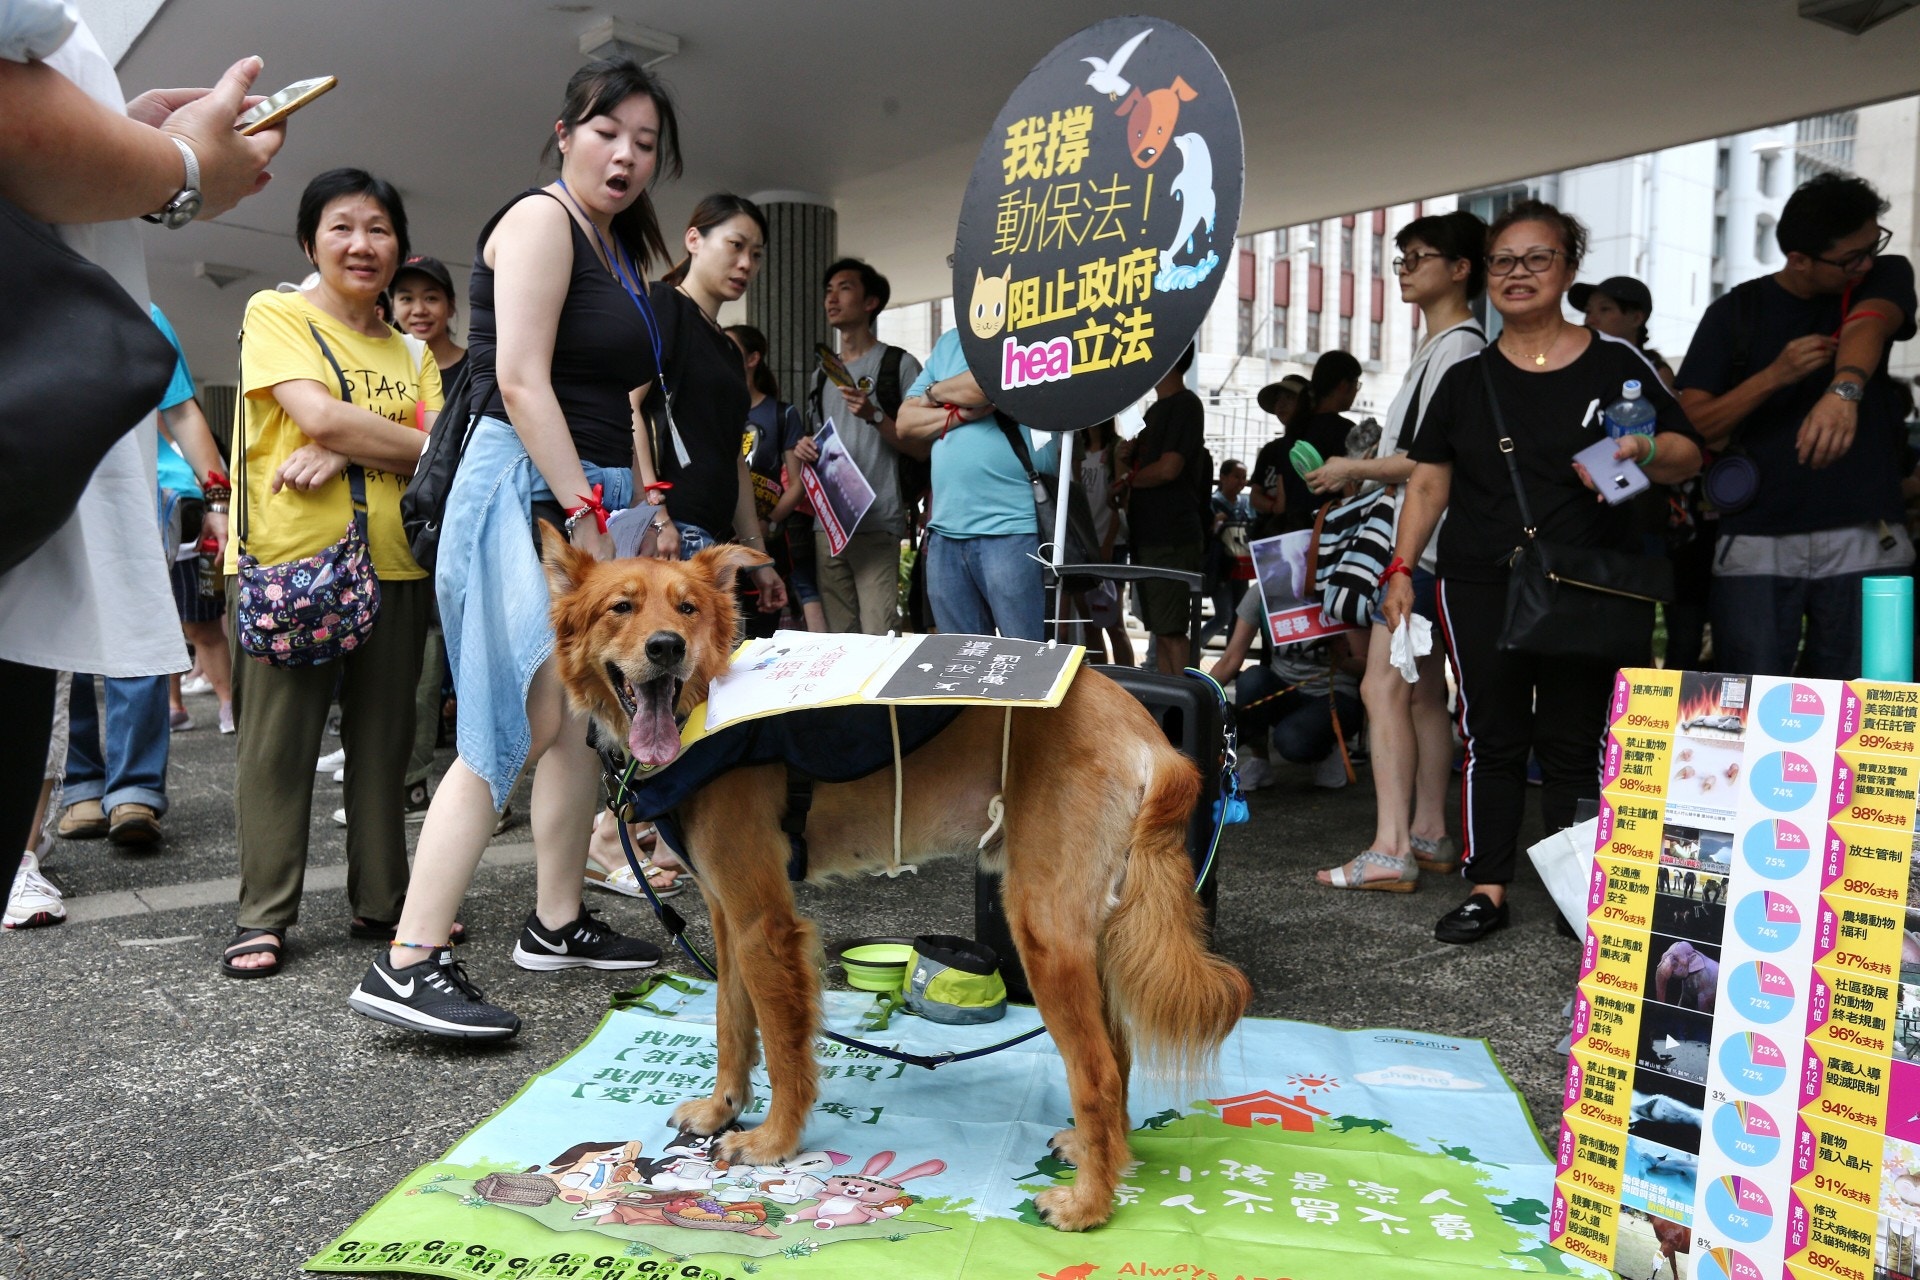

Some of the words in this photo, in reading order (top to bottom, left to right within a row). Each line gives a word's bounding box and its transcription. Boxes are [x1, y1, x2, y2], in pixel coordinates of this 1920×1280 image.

[1002, 104, 1094, 186] 我撐
[1007, 247, 1157, 333] 阻止政府
[1003, 338, 1071, 388] hea
[1071, 311, 1155, 375] 立法
[1616, 681, 1627, 713] 第1位
[1632, 684, 1674, 698] 提高刑罰
[1795, 694, 1817, 704] 25%
[1866, 688, 1919, 703] 寵物店及
[1844, 697, 1856, 733] 第2位
[1864, 703, 1918, 718] 美容謹慎
[1627, 714, 1670, 729] 99%支持
[1780, 718, 1802, 728] 74%
[1863, 718, 1917, 733] 責任託管
[1626, 737, 1667, 751] 禁止動物
[1859, 734, 1915, 752] 99%支持
[1608, 744, 1618, 777] 第3位
[1788, 763, 1809, 773] 24%
[1858, 763, 1908, 777] 售賣及繁殖
[1622, 765, 1653, 776] 去貓爪
[1856, 774, 1897, 786] 規管落實
[1619, 778, 1662, 794] 98%支持
[1772, 788, 1793, 798] 74%
[1836, 768, 1848, 804] 第4位
[1855, 785, 1916, 800] 貓隻及寵物鼠
[1617, 805, 1659, 821] 飼主謹慎
[1851, 806, 1907, 826] 98%支持
[1600, 807, 1610, 840] 第5位
[1616, 818, 1637, 831] 責任
[1780, 832, 1801, 843] 23%
[1611, 842, 1654, 860] 98%支持
[1828, 839, 1841, 876] 第6位
[1849, 844, 1903, 863] 放生管制
[1610, 865, 1641, 879] 交通應
[1765, 857, 1786, 868] 75%
[1592, 871, 1603, 904] 第7位
[1608, 879, 1650, 895] 顧及動物
[1843, 878, 1899, 900] 98%支持
[1607, 891, 1628, 905] 安全
[1603, 906, 1646, 926] 97%支持
[1772, 903, 1794, 914] 23%
[1842, 910, 1896, 930] 農場動物
[1757, 927, 1778, 938] 74%
[1821, 911, 1833, 949] 第8位
[1841, 925, 1868, 940] 福利
[1584, 936, 1595, 968] 第9位
[1602, 934, 1643, 952] 禁止馬戲
[1600, 948, 1631, 964] 團表演
[1836, 951, 1892, 975] 97%支持
[1596, 971, 1638, 992] 96%支持
[1764, 973, 1786, 986] 24%
[1835, 978, 1889, 1000] 社區發展
[1594, 995, 1636, 1014] 精神創傷
[1750, 998, 1771, 1010] 72%
[1813, 984, 1825, 1022] 第10位
[1833, 993, 1874, 1012] 的動物
[1576, 1000, 1587, 1034] 第11位
[1593, 1007, 1623, 1025] 可列為
[1832, 1008, 1886, 1030] 終老規劃
[1590, 1022, 1612, 1036] 虐待
[1828, 1025, 1885, 1051] 96%支持
[1588, 1036, 1631, 1059] 95%支持
[1757, 1044, 1779, 1058] 23%
[1380, 1070, 1451, 1086] sharing
[1586, 1060, 1628, 1081] 禁止售賣
[1742, 1068, 1763, 1082] 72%
[1805, 1057, 1818, 1096] 第12位
[1569, 1065, 1579, 1100] 第13位
[1826, 1074, 1880, 1097] 毀滅限制
[1583, 1088, 1614, 1106] 曼基貓
[1712, 1090, 1726, 1101] 3%
[1580, 1102, 1623, 1127] 92%支持
[1821, 1099, 1878, 1127] 94%支持
[1749, 1116, 1771, 1131] 22%
[1561, 1131, 1572, 1166] 第15位
[1578, 1133, 1620, 1156] 管制動物
[1734, 1140, 1756, 1155] 70%
[1820, 1131, 1848, 1150] 寵物
[1577, 1147, 1618, 1171] 公園圈養
[1799, 1131, 1811, 1171] 第14位
[1818, 1146, 1873, 1173] 殖入晶片
[1572, 1169, 1616, 1195] 91%支持
[1814, 1174, 1872, 1205] 91%支持
[1571, 1193, 1613, 1218] 競賽馬匹
[1742, 1189, 1764, 1204] 24%
[1553, 1197, 1564, 1232] 第17位
[1570, 1208, 1601, 1228] 被人道
[1727, 1213, 1749, 1228] 67%
[1814, 1203, 1837, 1220] 修改
[1568, 1221, 1610, 1246] 毀滅限制
[1791, 1206, 1804, 1246] 第16位
[1812, 1216, 1872, 1246] 狂犬病條例
[1565, 1236, 1608, 1264] 88%支持
[1697, 1237, 1712, 1249] 8%
[1811, 1229, 1870, 1260] 及貓狗條例
[1118, 1262, 1217, 1280] Always
[1735, 1263, 1757, 1279] 23%
[1807, 1250, 1865, 1280] 89%支持
